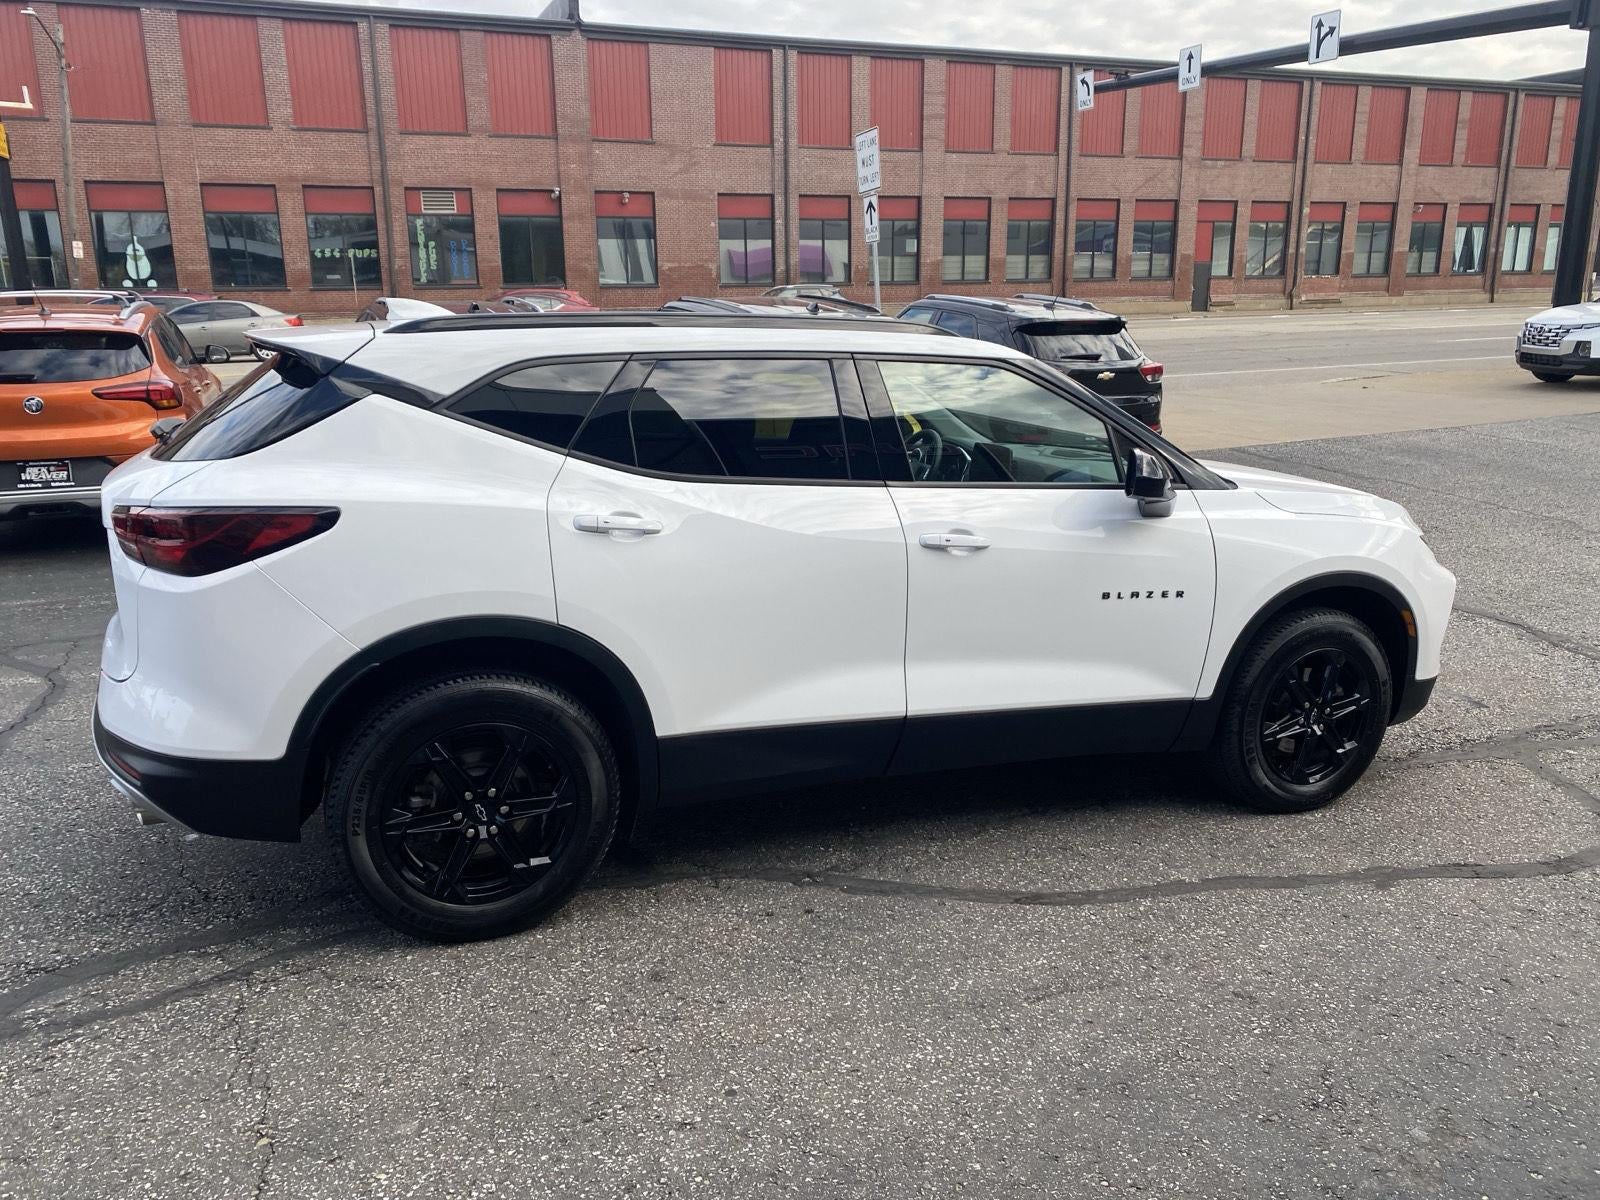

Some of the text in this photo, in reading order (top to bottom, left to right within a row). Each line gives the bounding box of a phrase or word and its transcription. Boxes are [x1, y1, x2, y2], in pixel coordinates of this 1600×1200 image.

[1182, 75, 1198, 86] ONLY
[1080, 99, 1092, 108] ONLY
[858, 135, 878, 151] LEFT LANE
[862, 154, 875, 168] MUST
[860, 171, 880, 186] TURN LEFT
[21, 471, 68, 480] WEAVER
[1101, 590, 1185, 600] BLAZER
